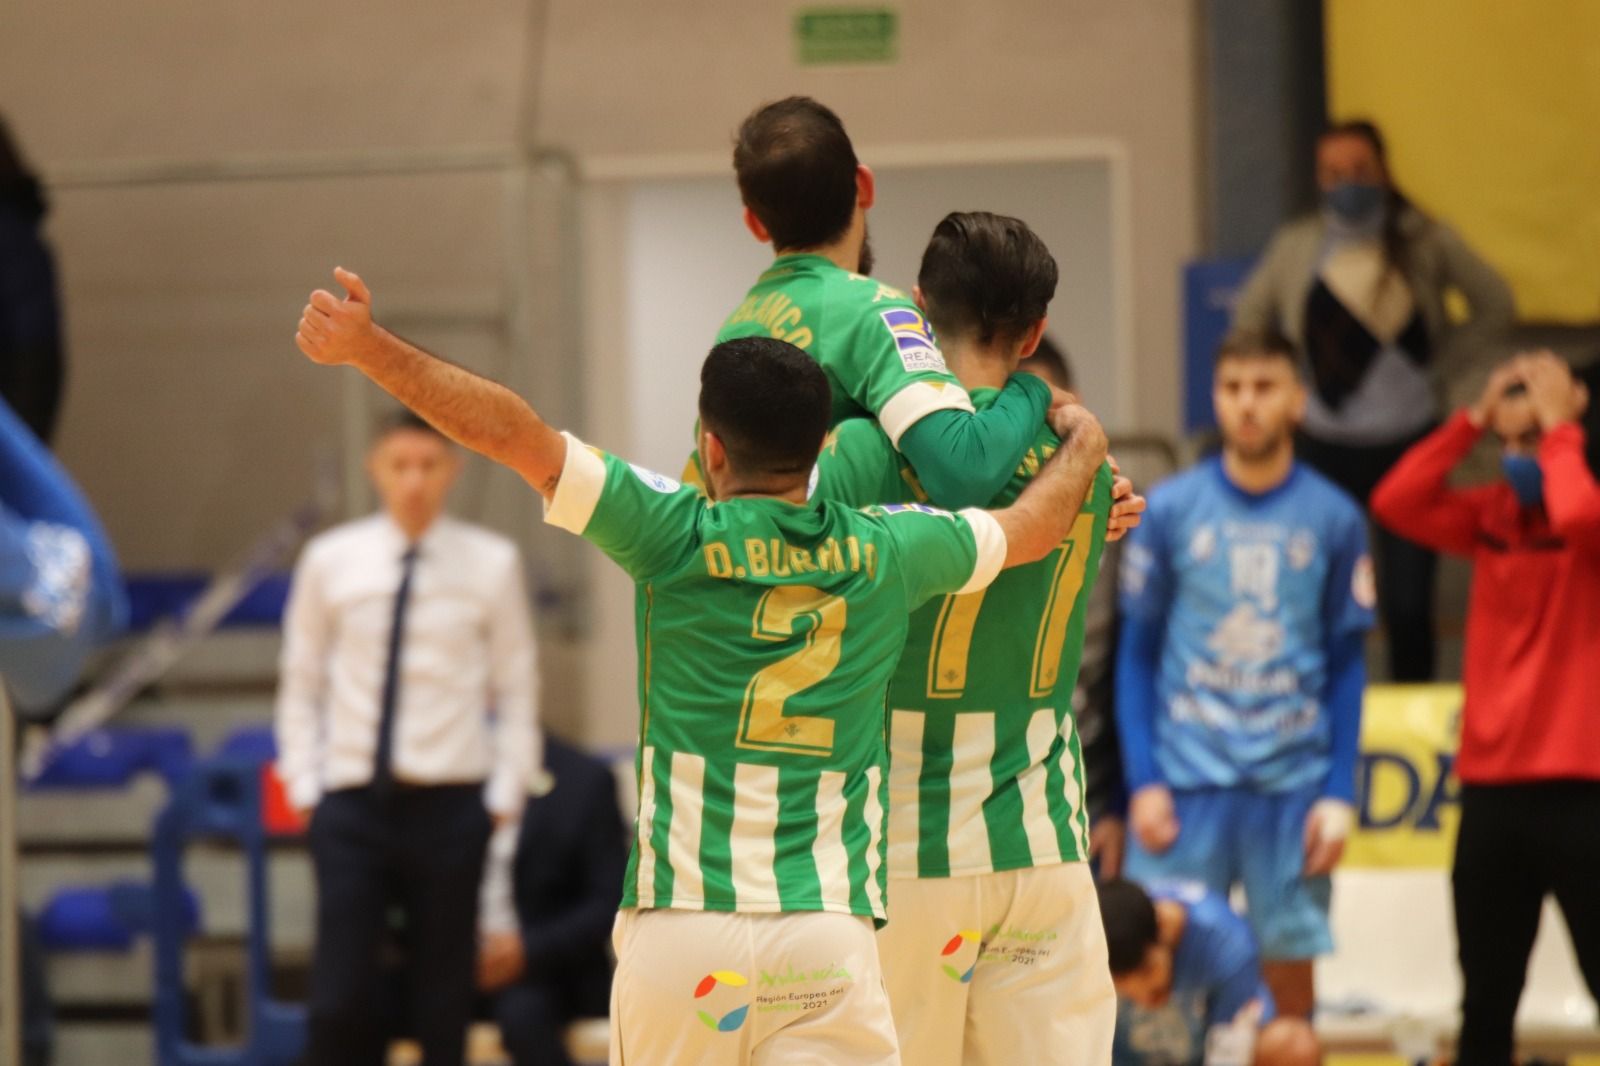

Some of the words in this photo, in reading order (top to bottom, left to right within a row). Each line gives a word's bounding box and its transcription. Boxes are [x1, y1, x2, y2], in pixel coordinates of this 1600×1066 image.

[735, 585, 847, 757] 2
[789, 991, 827, 1000] Europea
[803, 1000, 827, 1010] 2021
